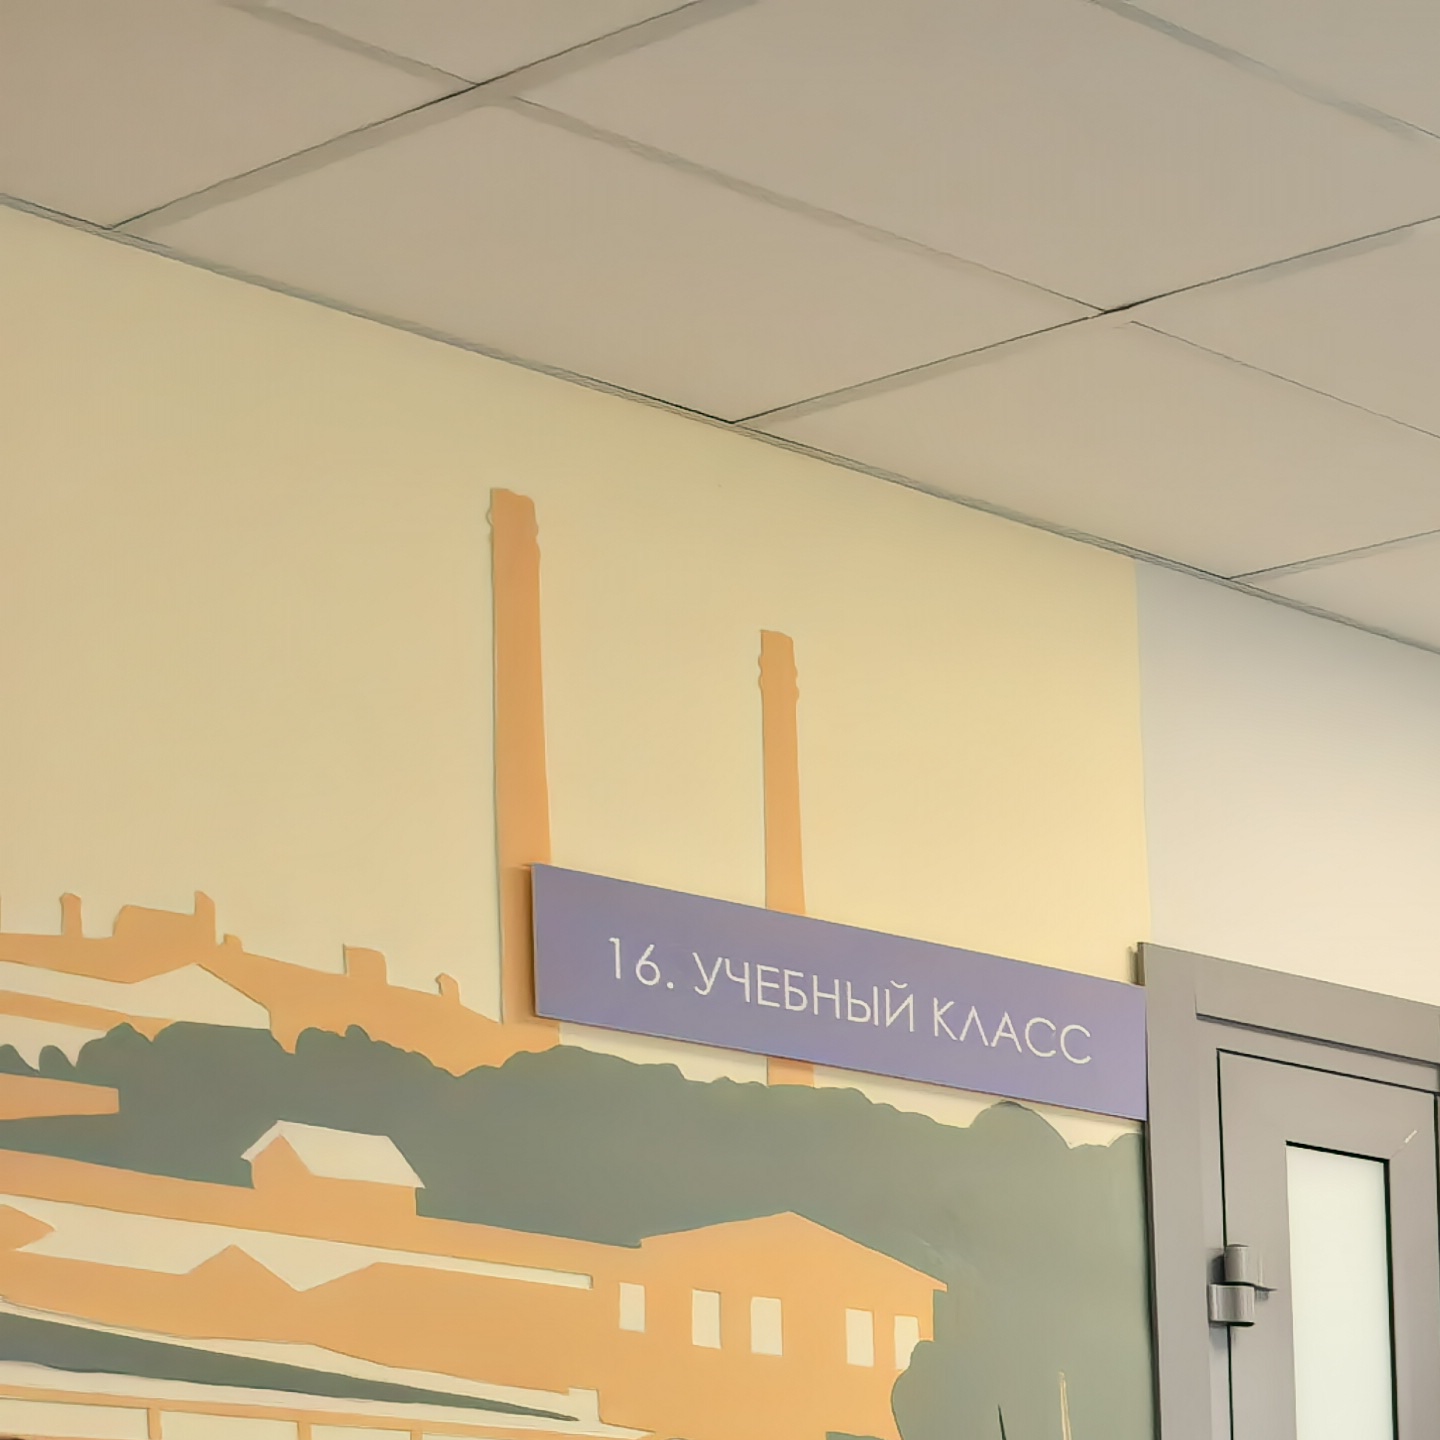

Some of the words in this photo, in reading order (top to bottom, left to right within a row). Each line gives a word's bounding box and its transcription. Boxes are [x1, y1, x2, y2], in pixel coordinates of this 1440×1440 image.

[609, 937, 675, 989] 16.
[692, 951, 915, 1032] УЧЕБНЫЙ
[932, 997, 1092, 1065] КЛАСС
